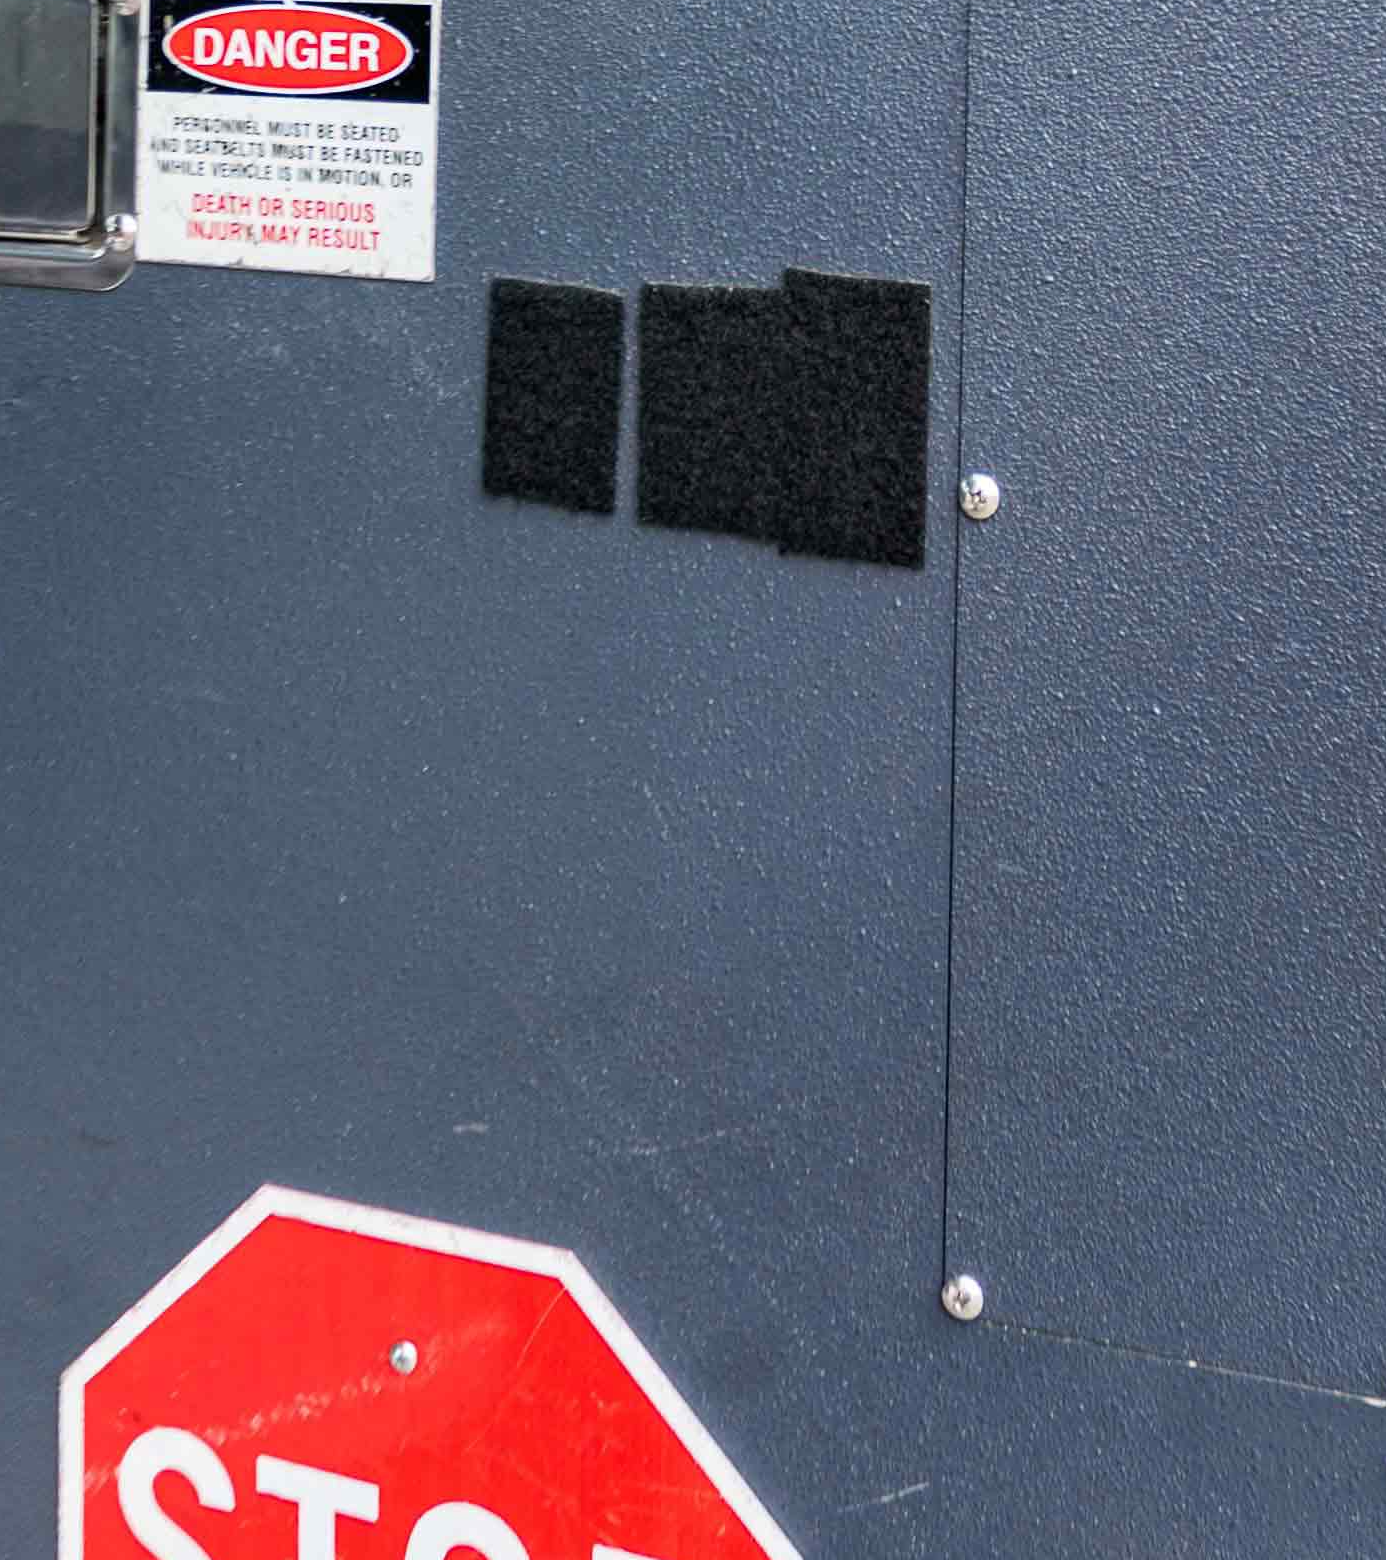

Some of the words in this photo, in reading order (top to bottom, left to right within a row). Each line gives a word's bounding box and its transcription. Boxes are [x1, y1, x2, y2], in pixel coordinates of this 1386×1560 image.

[192, 28, 381, 72] DANGER
[172, 116, 261, 136] PERSONNEL
[268, 121, 311, 137] MUST
[317, 123, 334, 140] BE
[341, 124, 399, 143] SEATED
[150, 137, 179, 153] AND
[184, 139, 264, 158] SEATBELTS
[272, 143, 314, 161] MUST
[320, 145, 339, 162] BE
[344, 147, 423, 167] FASTENED
[156, 160, 206, 177] WHILE
[212, 162, 273, 181] VEHICLE
[277, 166, 292, 182] IS
[297, 168, 312, 183] IN
[391, 172, 413, 189] OR
[191, 193, 251, 215] DEATH
[259, 197, 284, 217] OR
[292, 199, 375, 224] SERIOUS
[186, 220, 255, 241] INJURY
[261, 223, 301, 244] MAY
[308, 227, 381, 252] RESULT
